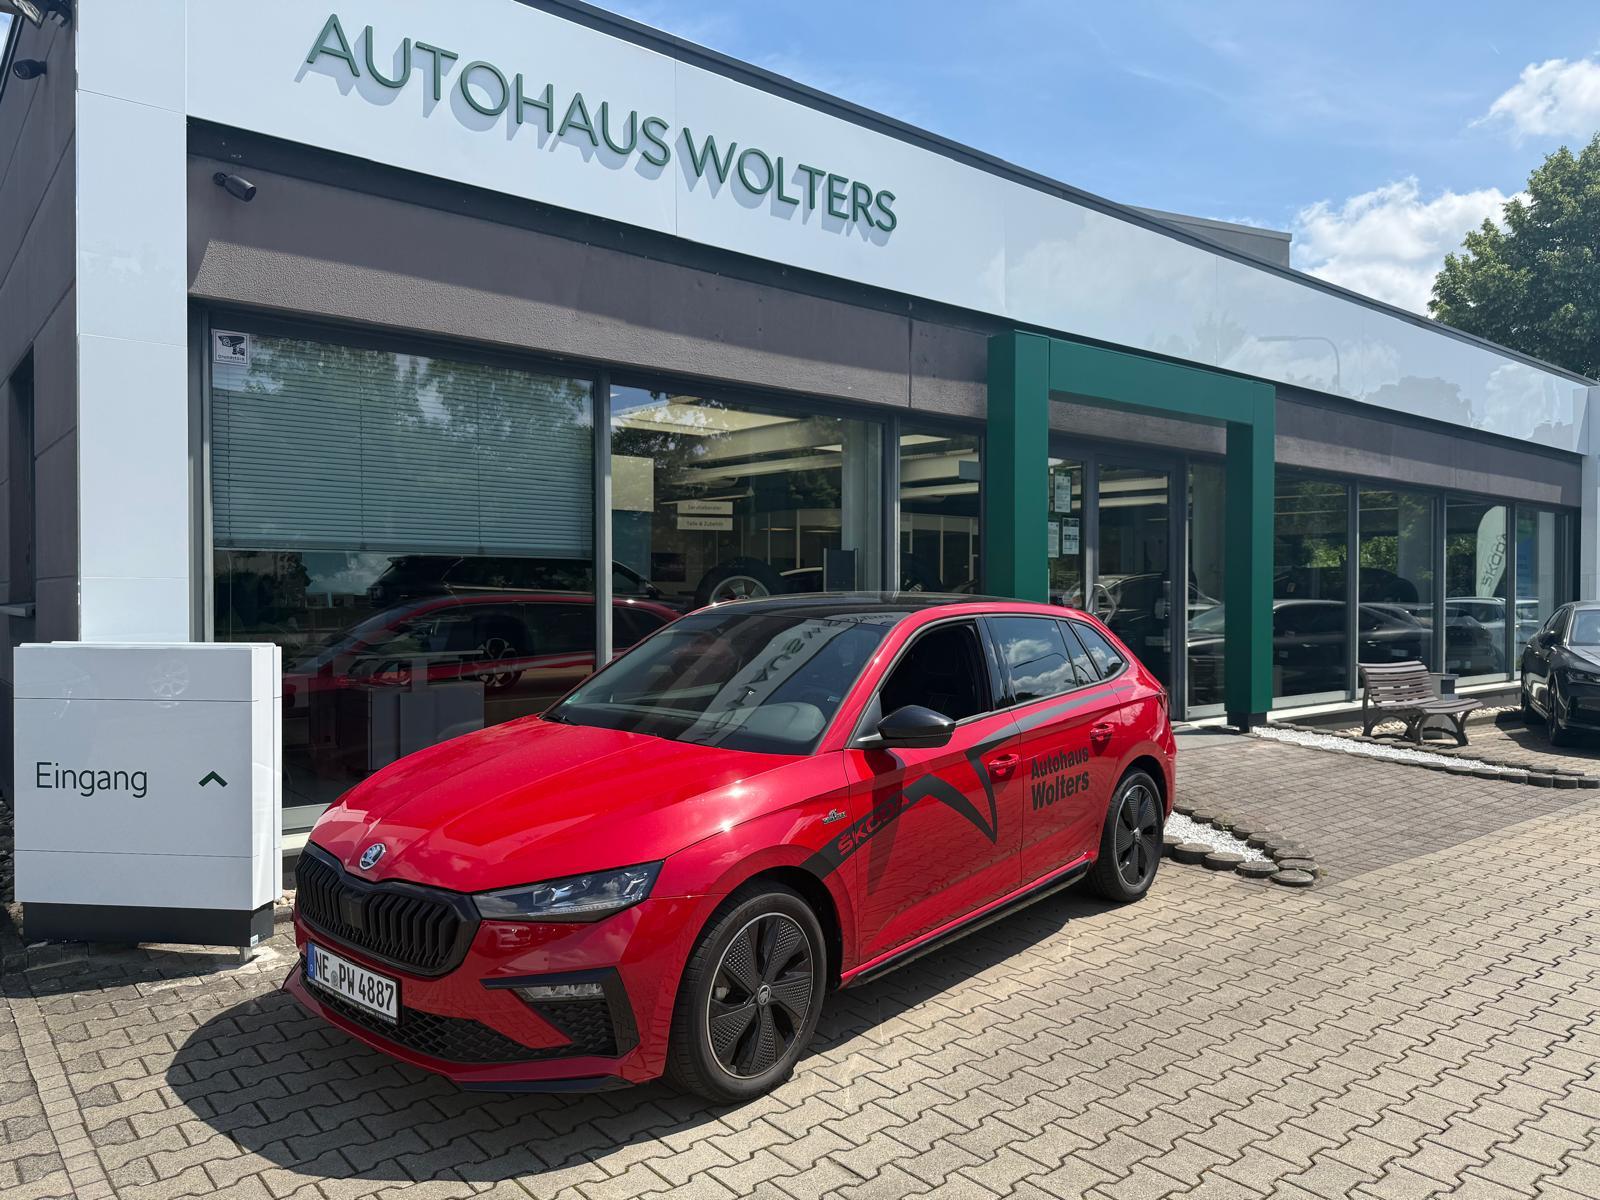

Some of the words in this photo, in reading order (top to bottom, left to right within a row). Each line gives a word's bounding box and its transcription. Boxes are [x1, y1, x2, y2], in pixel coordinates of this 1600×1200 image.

[305, 12, 672, 167] AUTOHAUS
[682, 127, 897, 232] WOLTERS
[36, 761, 147, 798] Eingang
[1031, 747, 1089, 780] Autohaus
[1031, 771, 1089, 811] Wolters
[315, 950, 330, 983] NE
[338, 962, 355, 996] PW
[358, 973, 394, 1011] 4887
